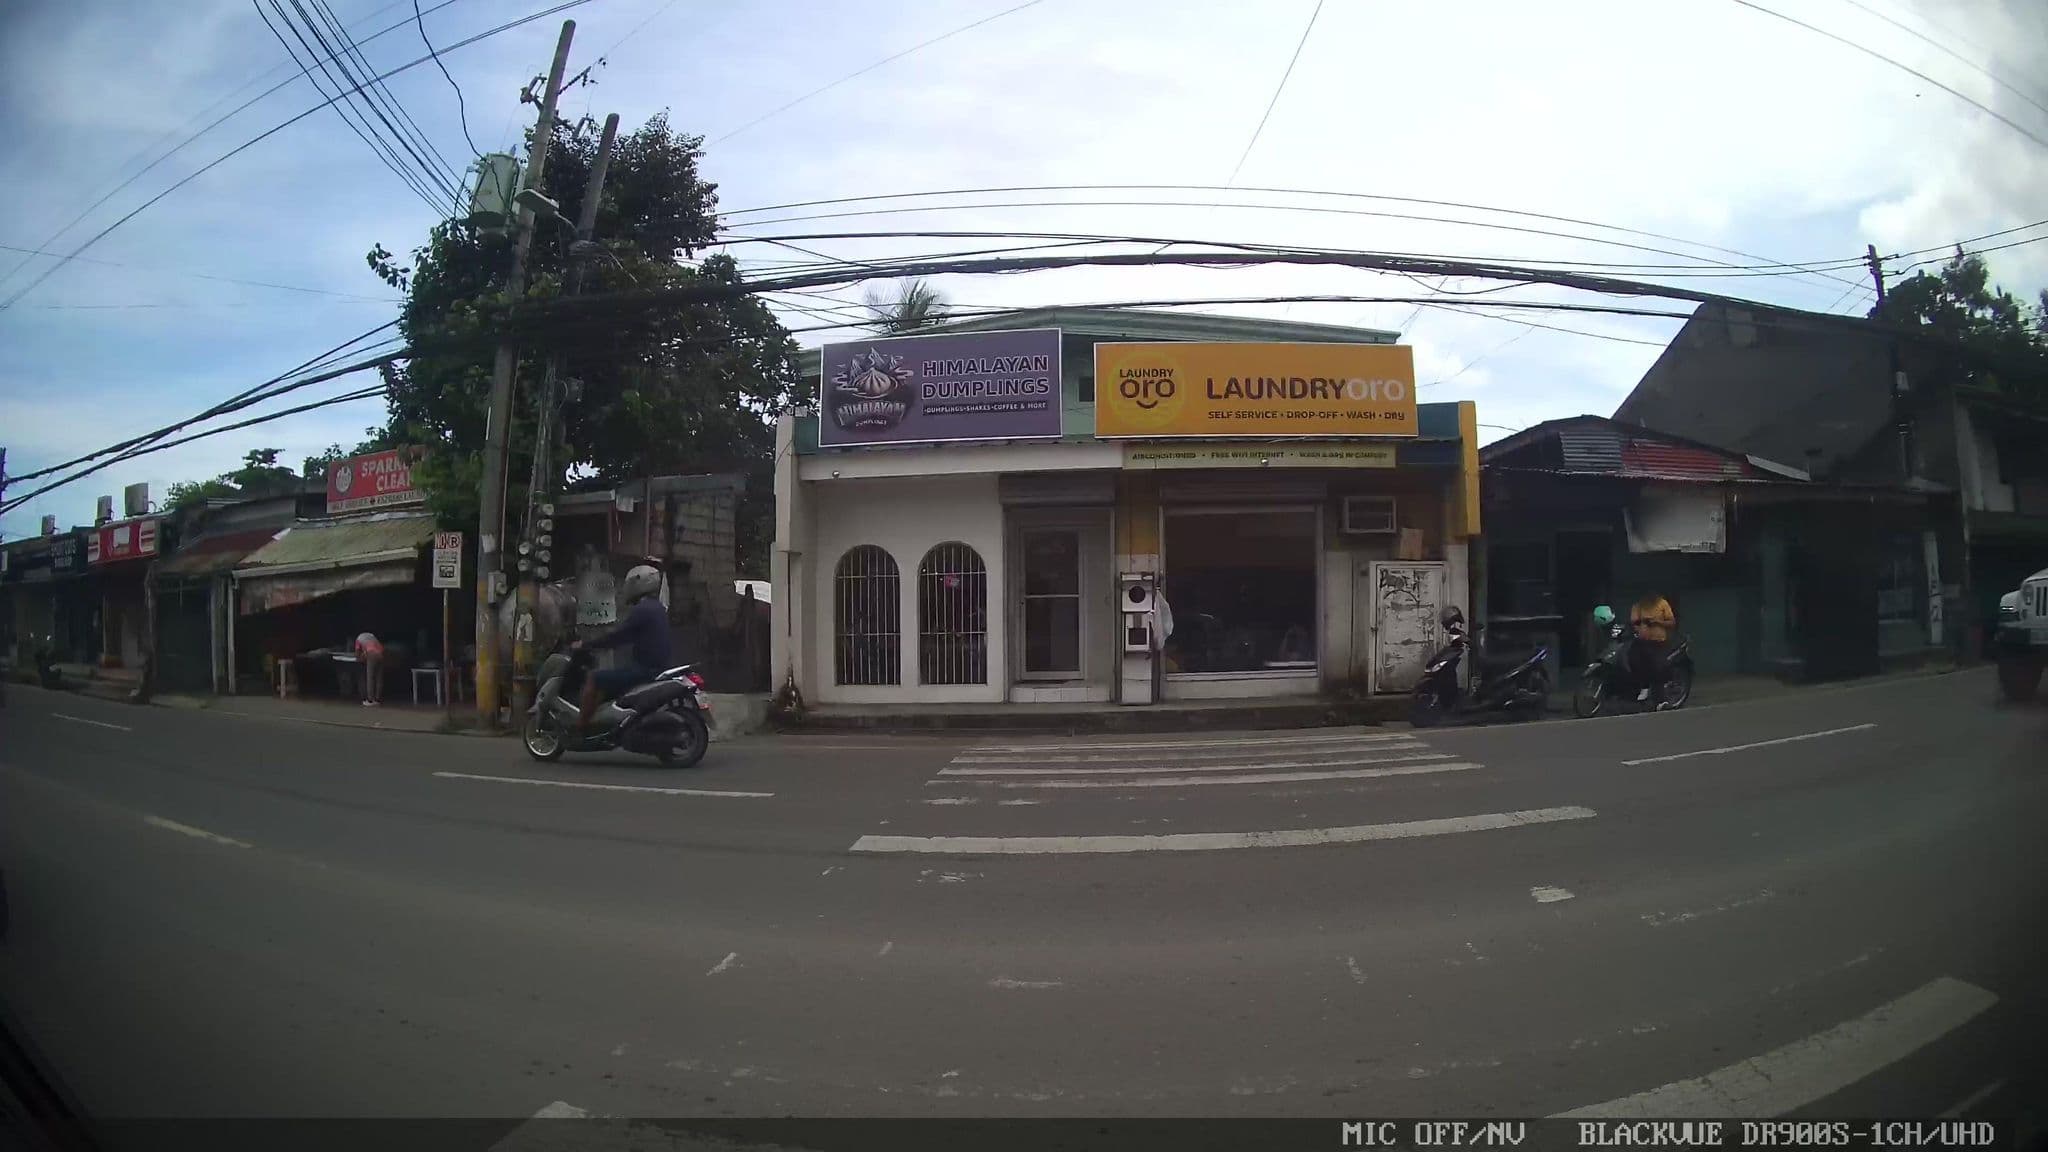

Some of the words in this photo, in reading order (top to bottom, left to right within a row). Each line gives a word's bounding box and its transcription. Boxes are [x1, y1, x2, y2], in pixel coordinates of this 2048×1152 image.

[922, 355, 1049, 377] HIMALAYAN
[1119, 368, 1174, 378] LAUNDRY
[921, 377, 1050, 400] DUMPLINGS
[1119, 378, 1176, 399] oro
[1027, 402, 1046, 410] MORE
[1208, 410, 1233, 419] SELF
[1234, 410, 1278, 419] SERVICE
[1286, 410, 1338, 419] DROP-OFF
[1346, 410, 1376, 420] WASH
